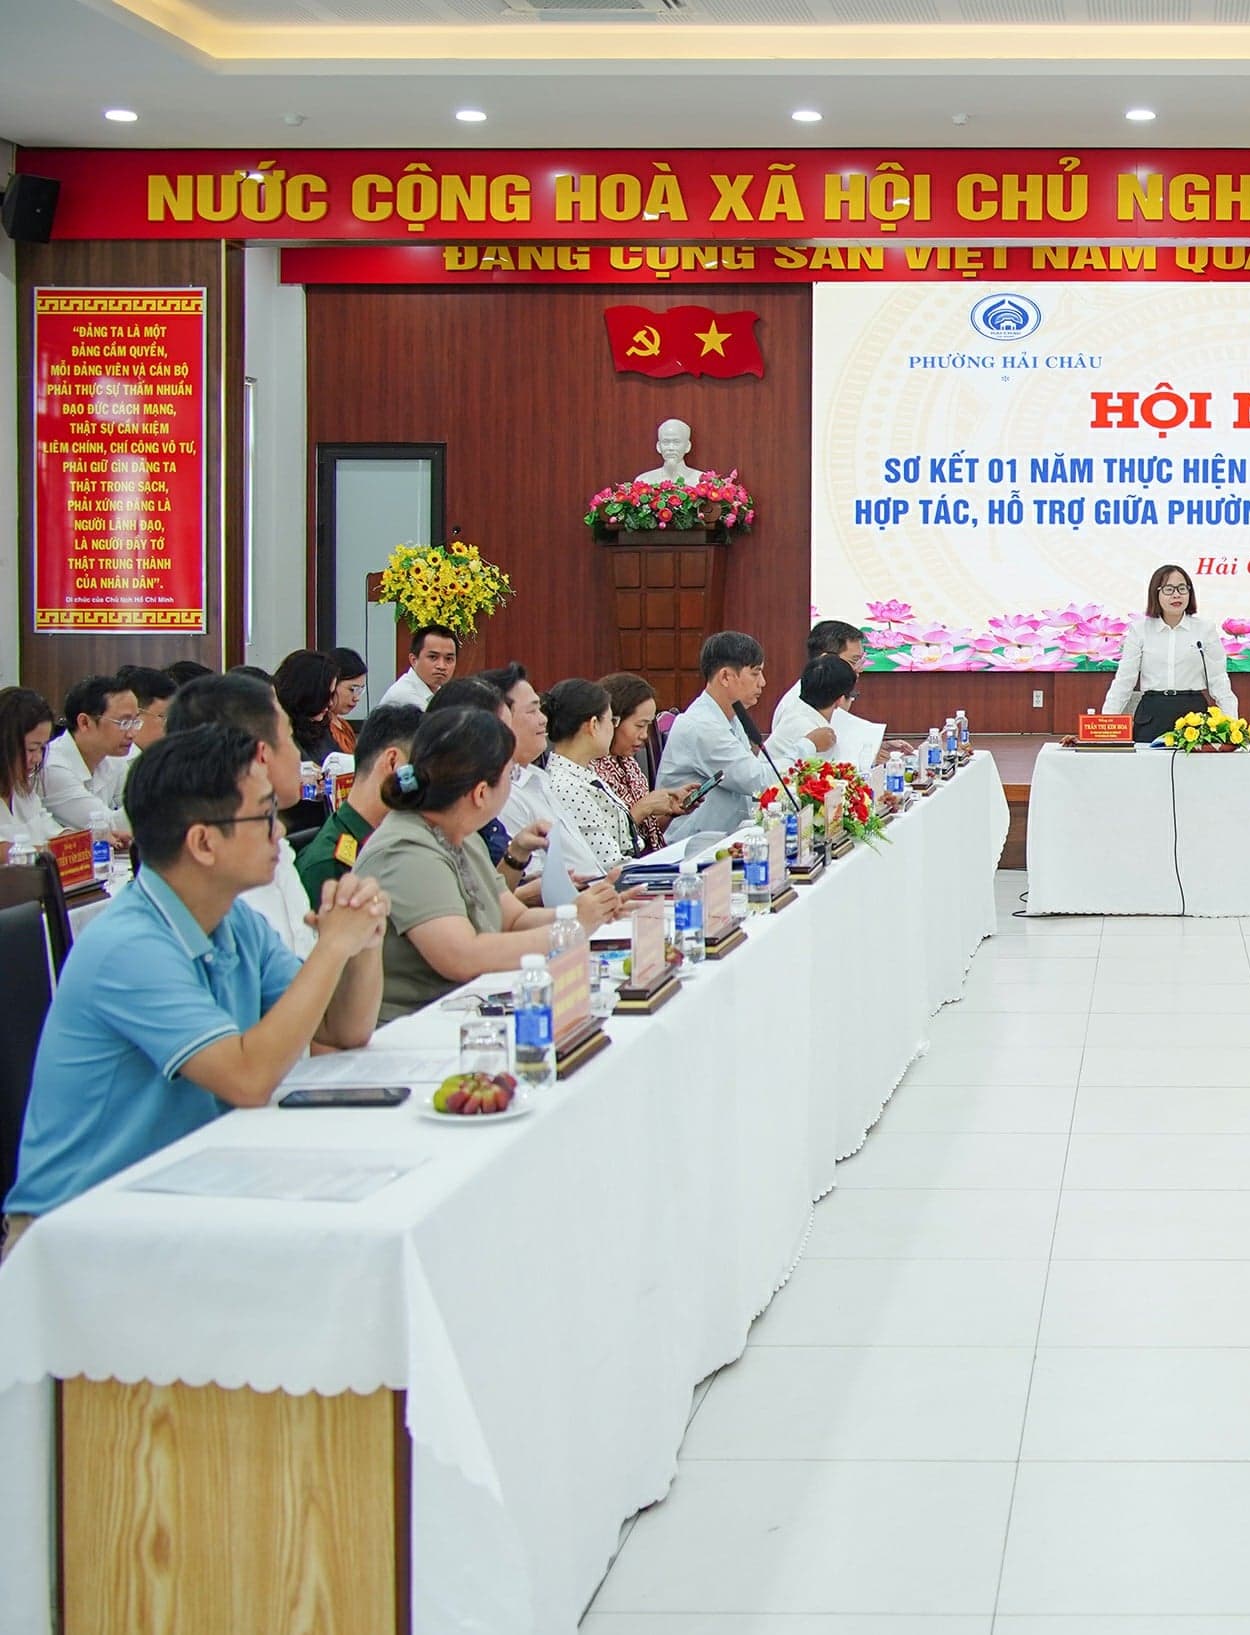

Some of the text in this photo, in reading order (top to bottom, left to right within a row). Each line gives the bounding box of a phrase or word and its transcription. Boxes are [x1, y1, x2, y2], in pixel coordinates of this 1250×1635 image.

[147, 161, 327, 222] NƯỚC
[351, 162, 531, 231] CỘNG
[554, 162, 688, 221] HOÀ
[710, 163, 804, 222] XÃ
[824, 162, 931, 231] HỘI
[957, 156, 1089, 222] CHỦ
[1032, 246, 1157, 271] NAM
[73, 323, 167, 339] “ĐẢNG TA LÀ MỘT
[72, 342, 100, 357] ĐẢNG
[51, 360, 188, 378] MỖI ĐẢNG VIÊN VÀ CÁN BỘ
[909, 352, 1102, 368] PHƯỜNG HẢI CHÂU
[1090, 382, 1212, 438] HỘI
[43, 439, 196, 455] LIÊM CHÍNH, CHÍ CÔNG VÔ TƯ,
[884, 456, 921, 484] SƠ
[930, 449, 978, 483] KẾT
[988, 459, 1017, 484] 01
[1031, 454, 1093, 483] NĂM
[1103, 456, 1172, 488] THỰC
[1184, 454, 1246, 488] HIỆN
[855, 498, 909, 530] HỢP
[919, 494, 977, 527] TÁC,
[989, 490, 1023, 525] HỖ
[1034, 498, 1085, 530] TRỢ
[1095, 495, 1158, 525] GIỮA
[68, 555, 171, 572] THẬT TRUNG THÀNH
[1195, 555, 1238, 575] Hải
[76, 574, 163, 588] CỦA NHÂN DÂN”.
